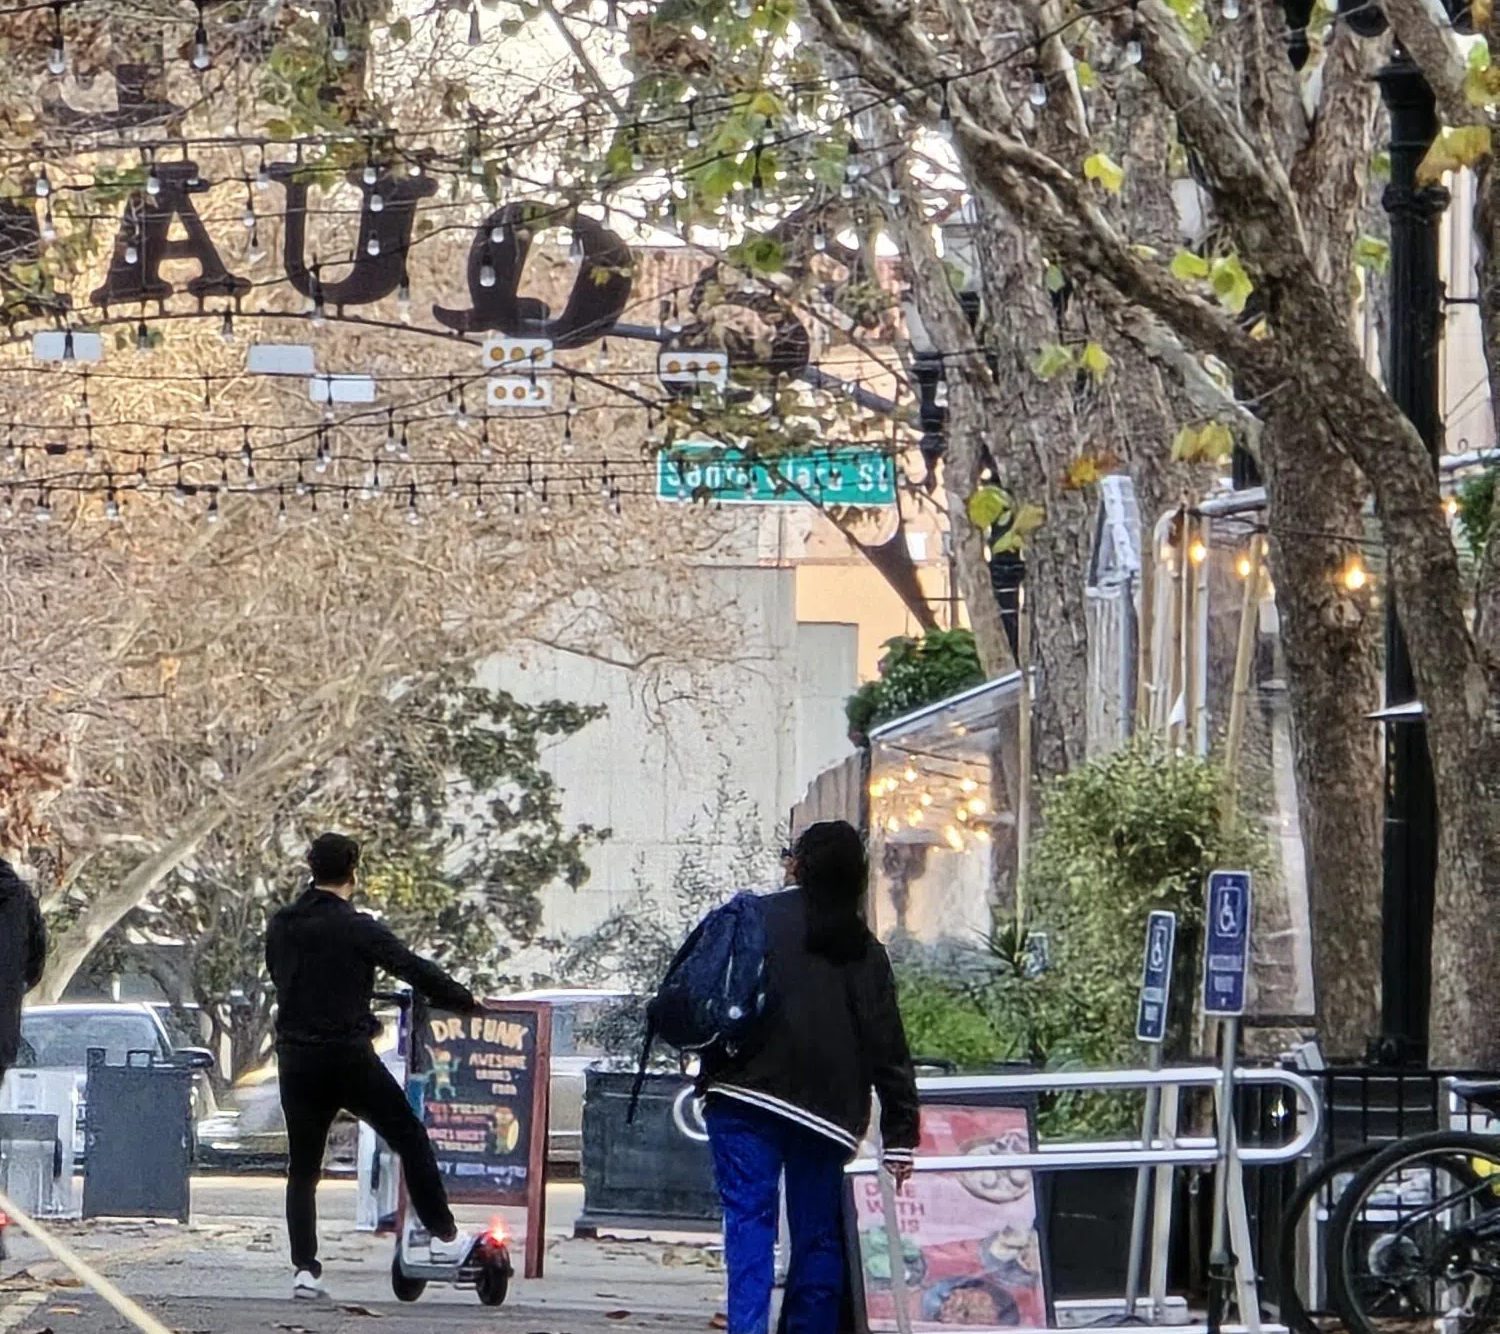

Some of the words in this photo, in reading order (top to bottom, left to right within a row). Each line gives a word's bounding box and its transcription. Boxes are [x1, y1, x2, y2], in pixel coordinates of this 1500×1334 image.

[857, 457, 889, 492] St
[430, 1017, 467, 1044] DR
[470, 1017, 529, 1051] FUNK
[864, 1182, 916, 1198] DE
[866, 1199, 925, 1216] WTH
